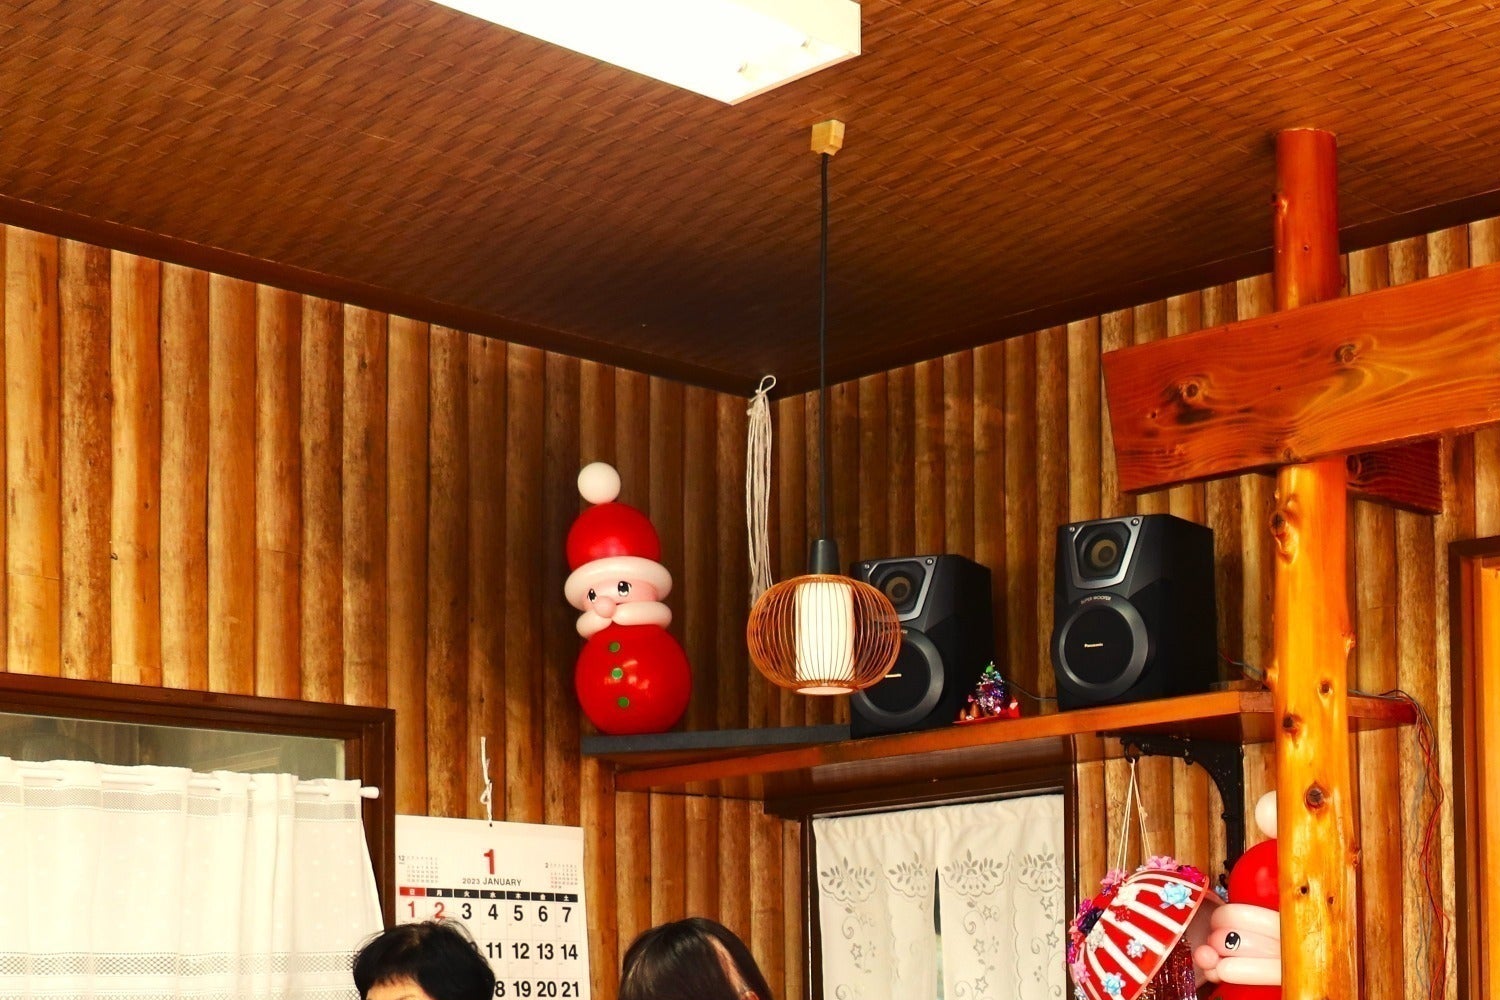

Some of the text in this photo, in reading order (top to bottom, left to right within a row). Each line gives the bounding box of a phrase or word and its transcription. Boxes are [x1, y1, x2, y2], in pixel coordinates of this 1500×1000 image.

[483, 849, 495, 874] 1
[483, 878, 522, 887] JANUARY
[408, 901, 572, 923] 1 2 3 4 5 6 7
[486, 942, 578, 960] 11 12 13 14
[495, 981, 579, 998] 8 19 20 21
